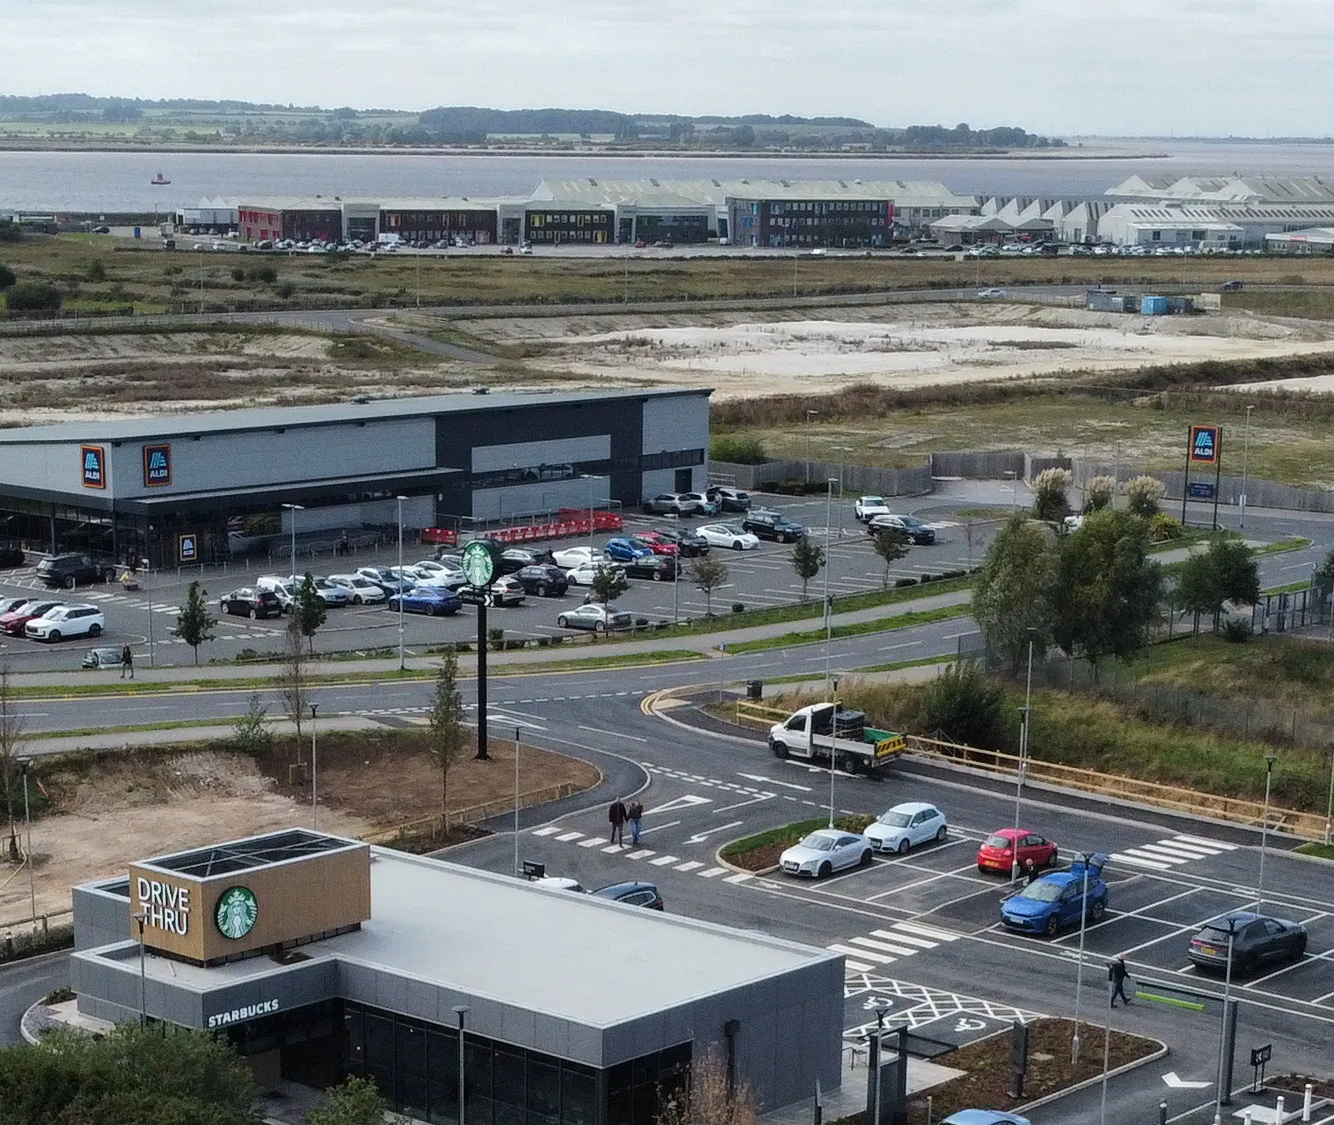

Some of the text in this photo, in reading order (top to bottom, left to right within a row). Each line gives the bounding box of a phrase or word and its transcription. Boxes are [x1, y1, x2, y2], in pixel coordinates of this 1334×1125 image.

[1194, 447, 1213, 456] ALDI
[150, 469, 168, 478] ALDI
[137, 877, 190, 912] DRIVE
[140, 902, 187, 935] THRU
[208, 999, 279, 1028] STARBUCKS
